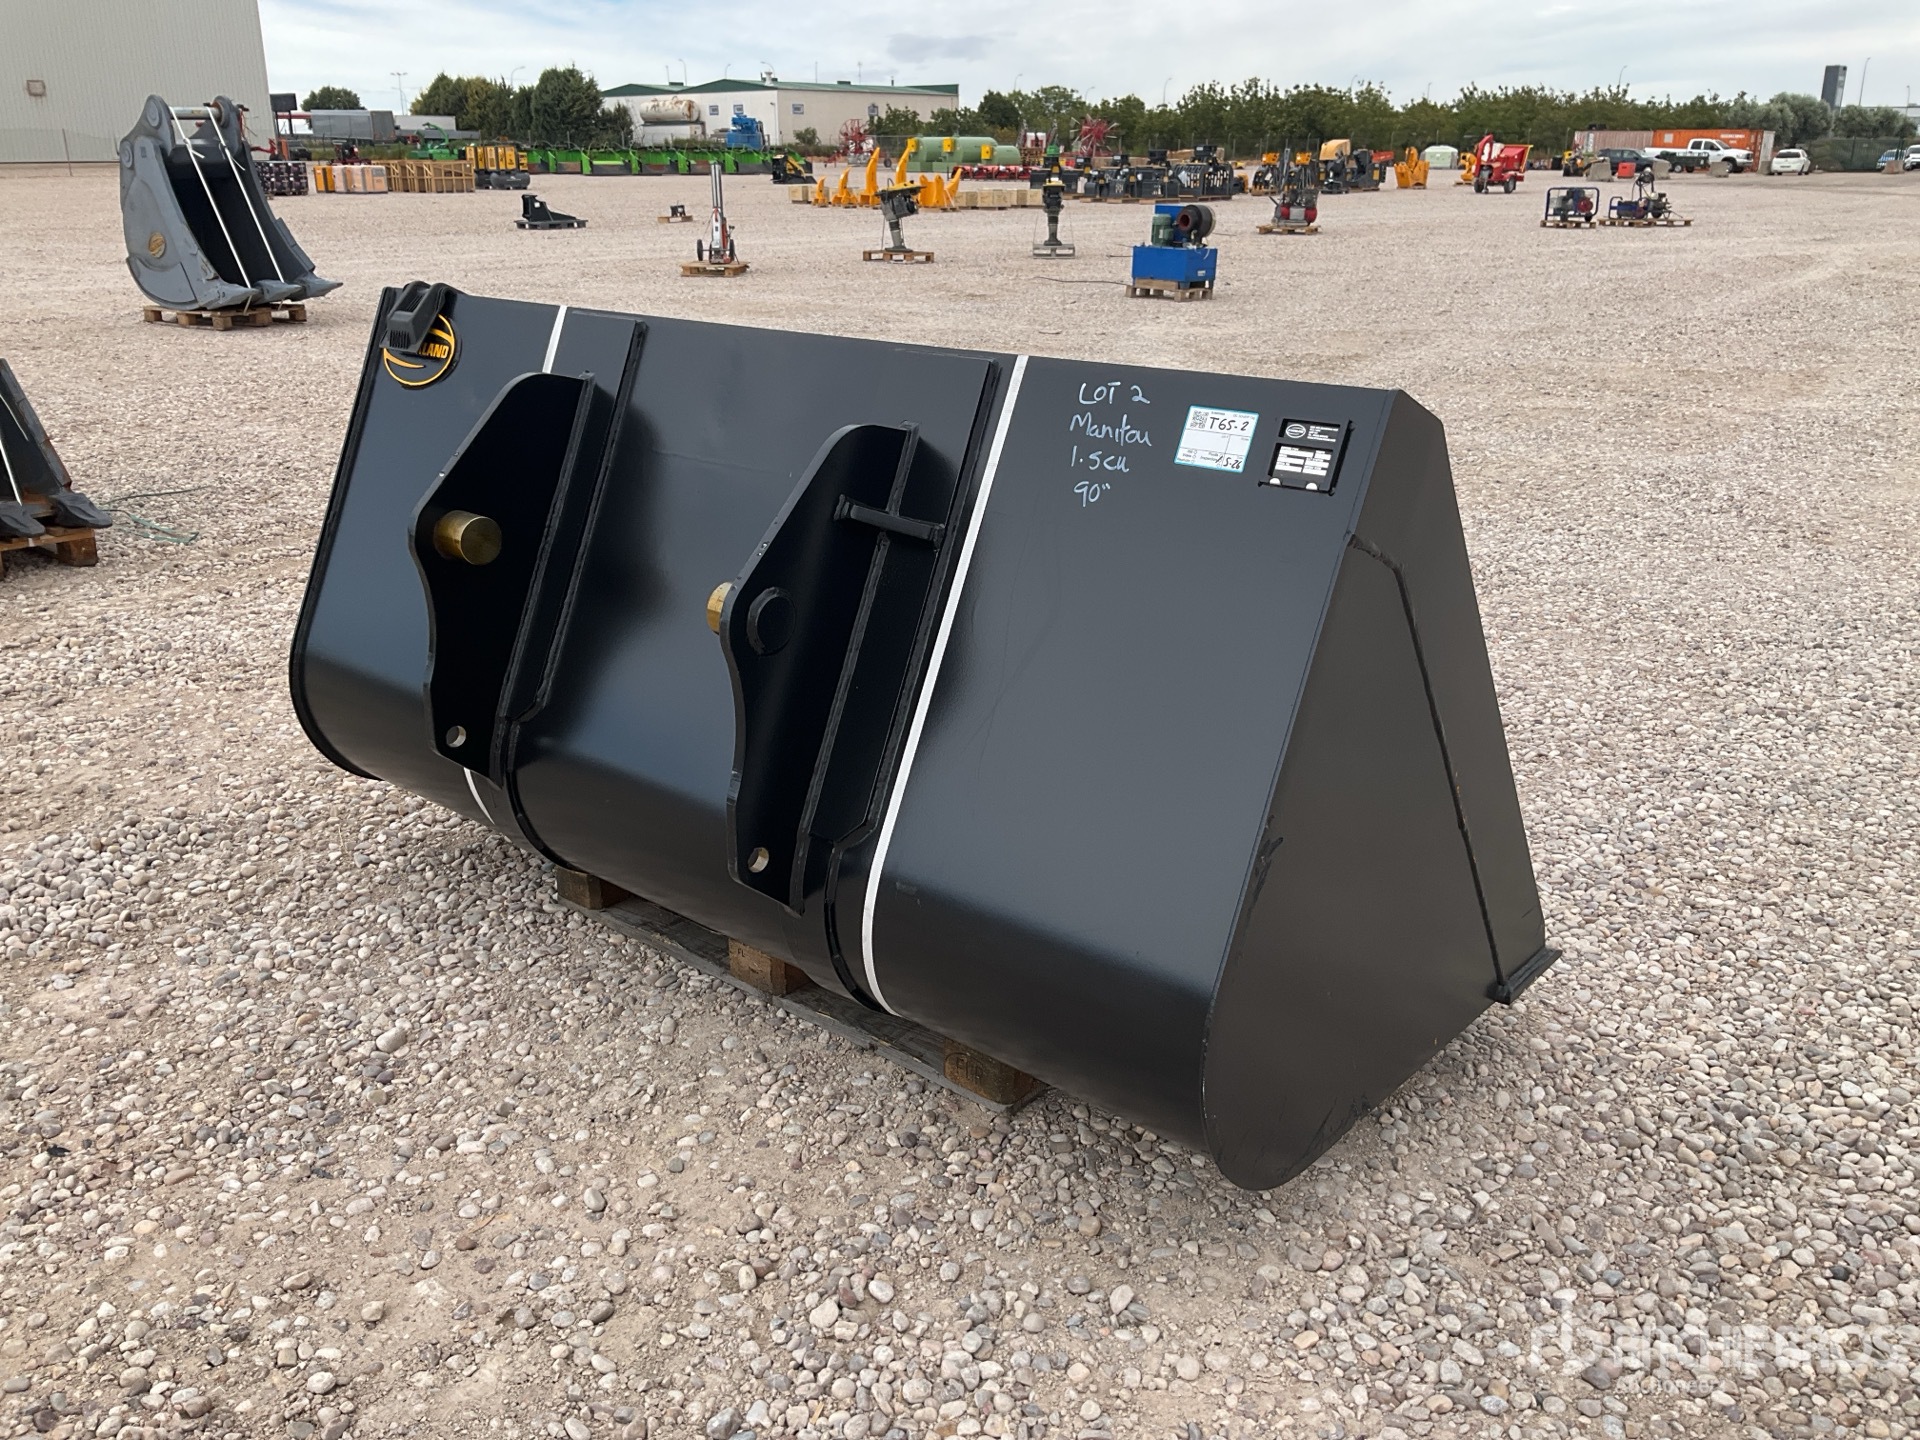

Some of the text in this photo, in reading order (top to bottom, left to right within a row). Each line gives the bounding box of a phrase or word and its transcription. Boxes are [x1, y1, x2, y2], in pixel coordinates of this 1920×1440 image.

[418, 342, 450, 359] LAND
[1079, 381, 1151, 405] LOT 2
[1069, 411, 1152, 447] Manitou
